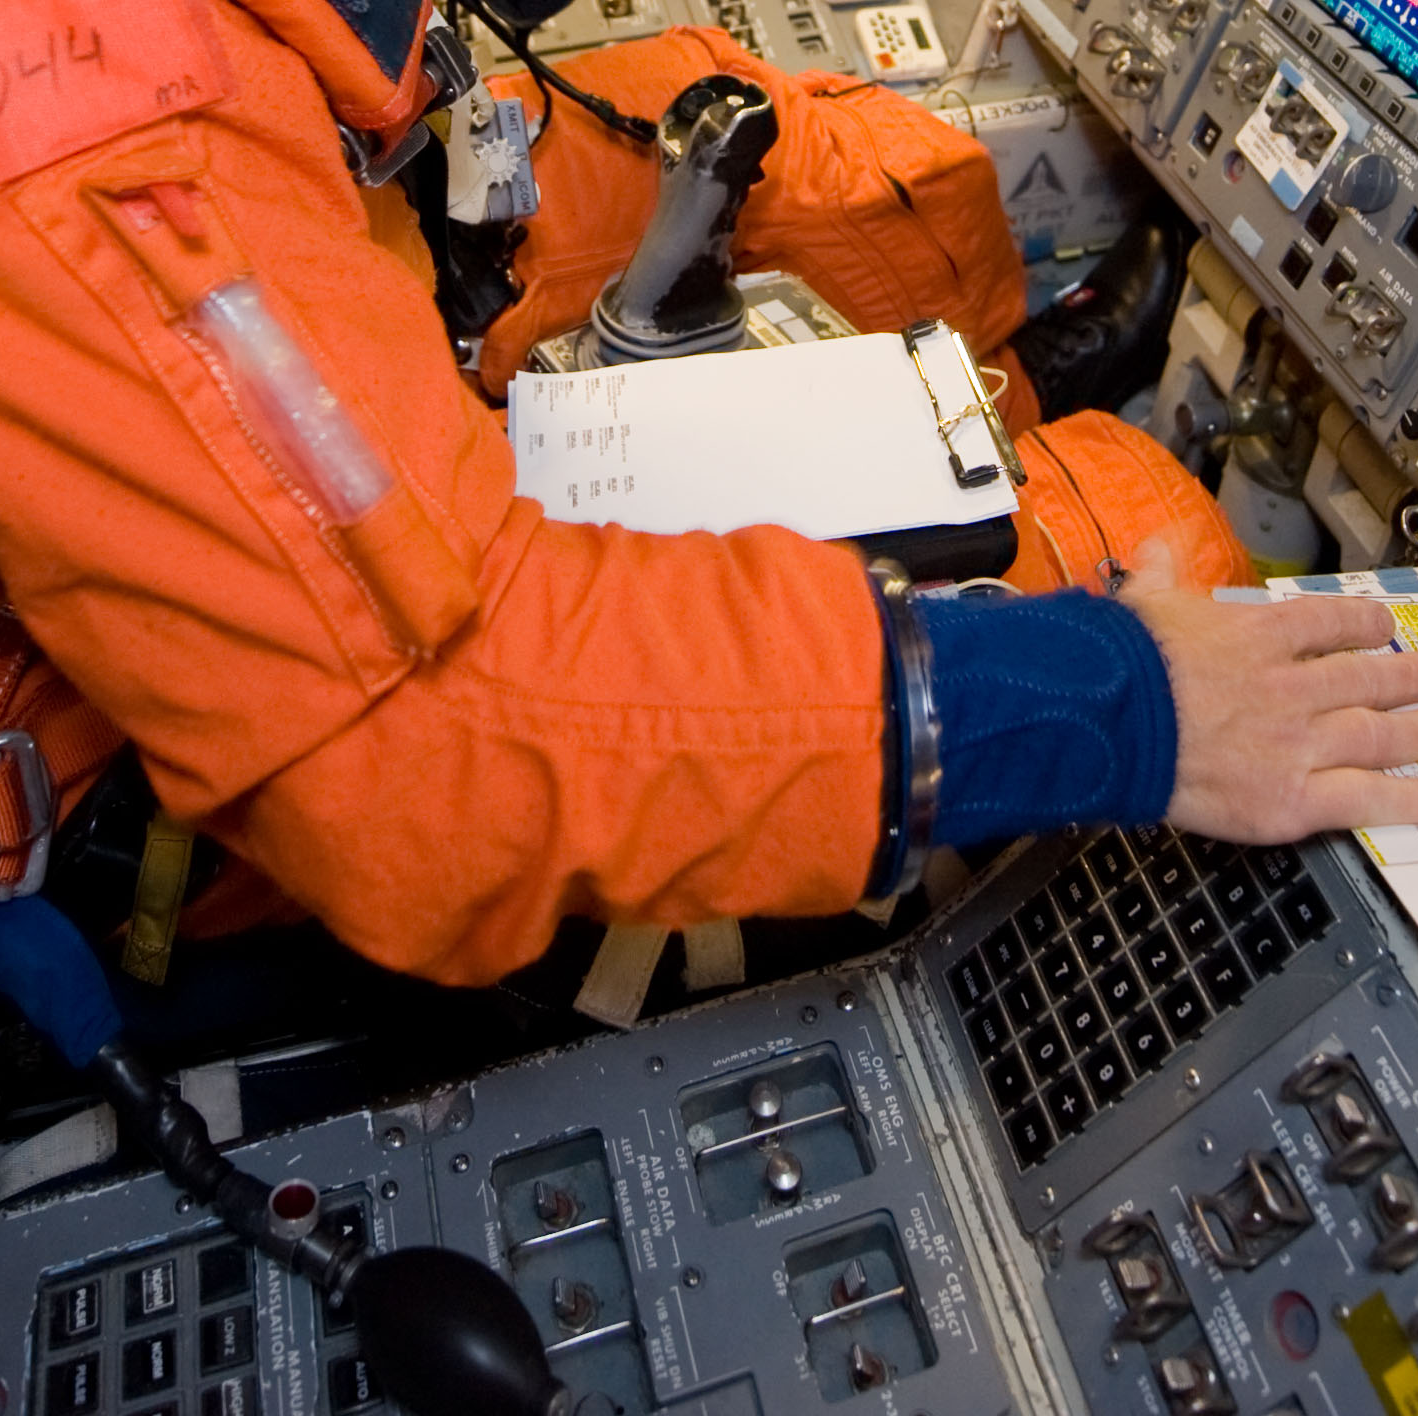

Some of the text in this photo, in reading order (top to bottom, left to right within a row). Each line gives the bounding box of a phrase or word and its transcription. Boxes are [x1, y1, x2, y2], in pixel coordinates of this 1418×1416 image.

[506, 105, 520, 132] XMIT
[976, 90, 1051, 128] POCKET
[1370, 122, 1399, 148] ABORT
[518, 180, 531, 211] ICOM
[1376, 267, 1416, 305] AIR DATA
[1162, 869, 1179, 883] D
[1227, 886, 1245, 901] B
[1126, 903, 1142, 916] 1
[1088, 932, 1106, 948] 4
[1188, 918, 1205, 932] E
[1149, 951, 1168, 967] 2
[1255, 938, 1272, 953] C
[959, 967, 982, 999] RESUME
[1052, 962, 1068, 977] 7
[1215, 969, 1232, 983] F
[1111, 981, 1129, 998] 5
[1074, 1012, 1092, 1028] 8
[1174, 1002, 1194, 1019] 3
[979, 1019, 998, 1042] CLEAR
[1136, 1032, 1154, 1049] 6
[857, 1049, 872, 1077] LEFT
[1038, 1043, 1056, 1058] 0
[1097, 1064, 1116, 1081] 9
[1373, 1054, 1413, 1110] POWER
[853, 1083, 873, 1113] ARM
[871, 1054, 906, 1128] OMS ENG
[1371, 1076, 1395, 1105] ON
[874, 1108, 898, 1148] RIGHT
[1023, 1124, 1038, 1142] PRO
[617, 1138, 636, 1166] LEFT
[672, 1145, 689, 1171] OFF
[1299, 1131, 1323, 1161] OFF
[647, 1153, 679, 1230] AIR DATA
[1268, 1118, 1340, 1235] LEFT CRT SEL
[612, 1178, 638, 1227] ENABLE
[631, 1153, 664, 1237] PROBE STOW
[756, 1191, 843, 1229] ARM/PRESS
[343, 1224, 353, 1235] A
[901, 1226, 920, 1251] ON
[905, 1206, 938, 1262] DISPLAY
[1169, 1221, 1203, 1268] MODE
[477, 1220, 506, 1270] INHIBIT
[636, 1227, 659, 1269] RIGHT
[1168, 1239, 1187, 1261] UP
[768, 1268, 789, 1298] OFF
[928, 1233, 967, 1304] BFC CRT
[152, 1267, 164, 1306] NORM
[1099, 1279, 1117, 1308] TEST
[76, 1288, 87, 1328] PULSE
[934, 1288, 963, 1337] SELECT
[1213, 1287, 1256, 1346] TIMER
[652, 1296, 684, 1389] VIB SHUT DN
[1200, 1318, 1235, 1365] START
[1205, 1305, 1258, 1381] CONTROL
[151, 1341, 163, 1380] NORM
[645, 1337, 670, 1380] RESET
[75, 1364, 87, 1405] PULSE
[355, 1361, 369, 1401] AUTO
